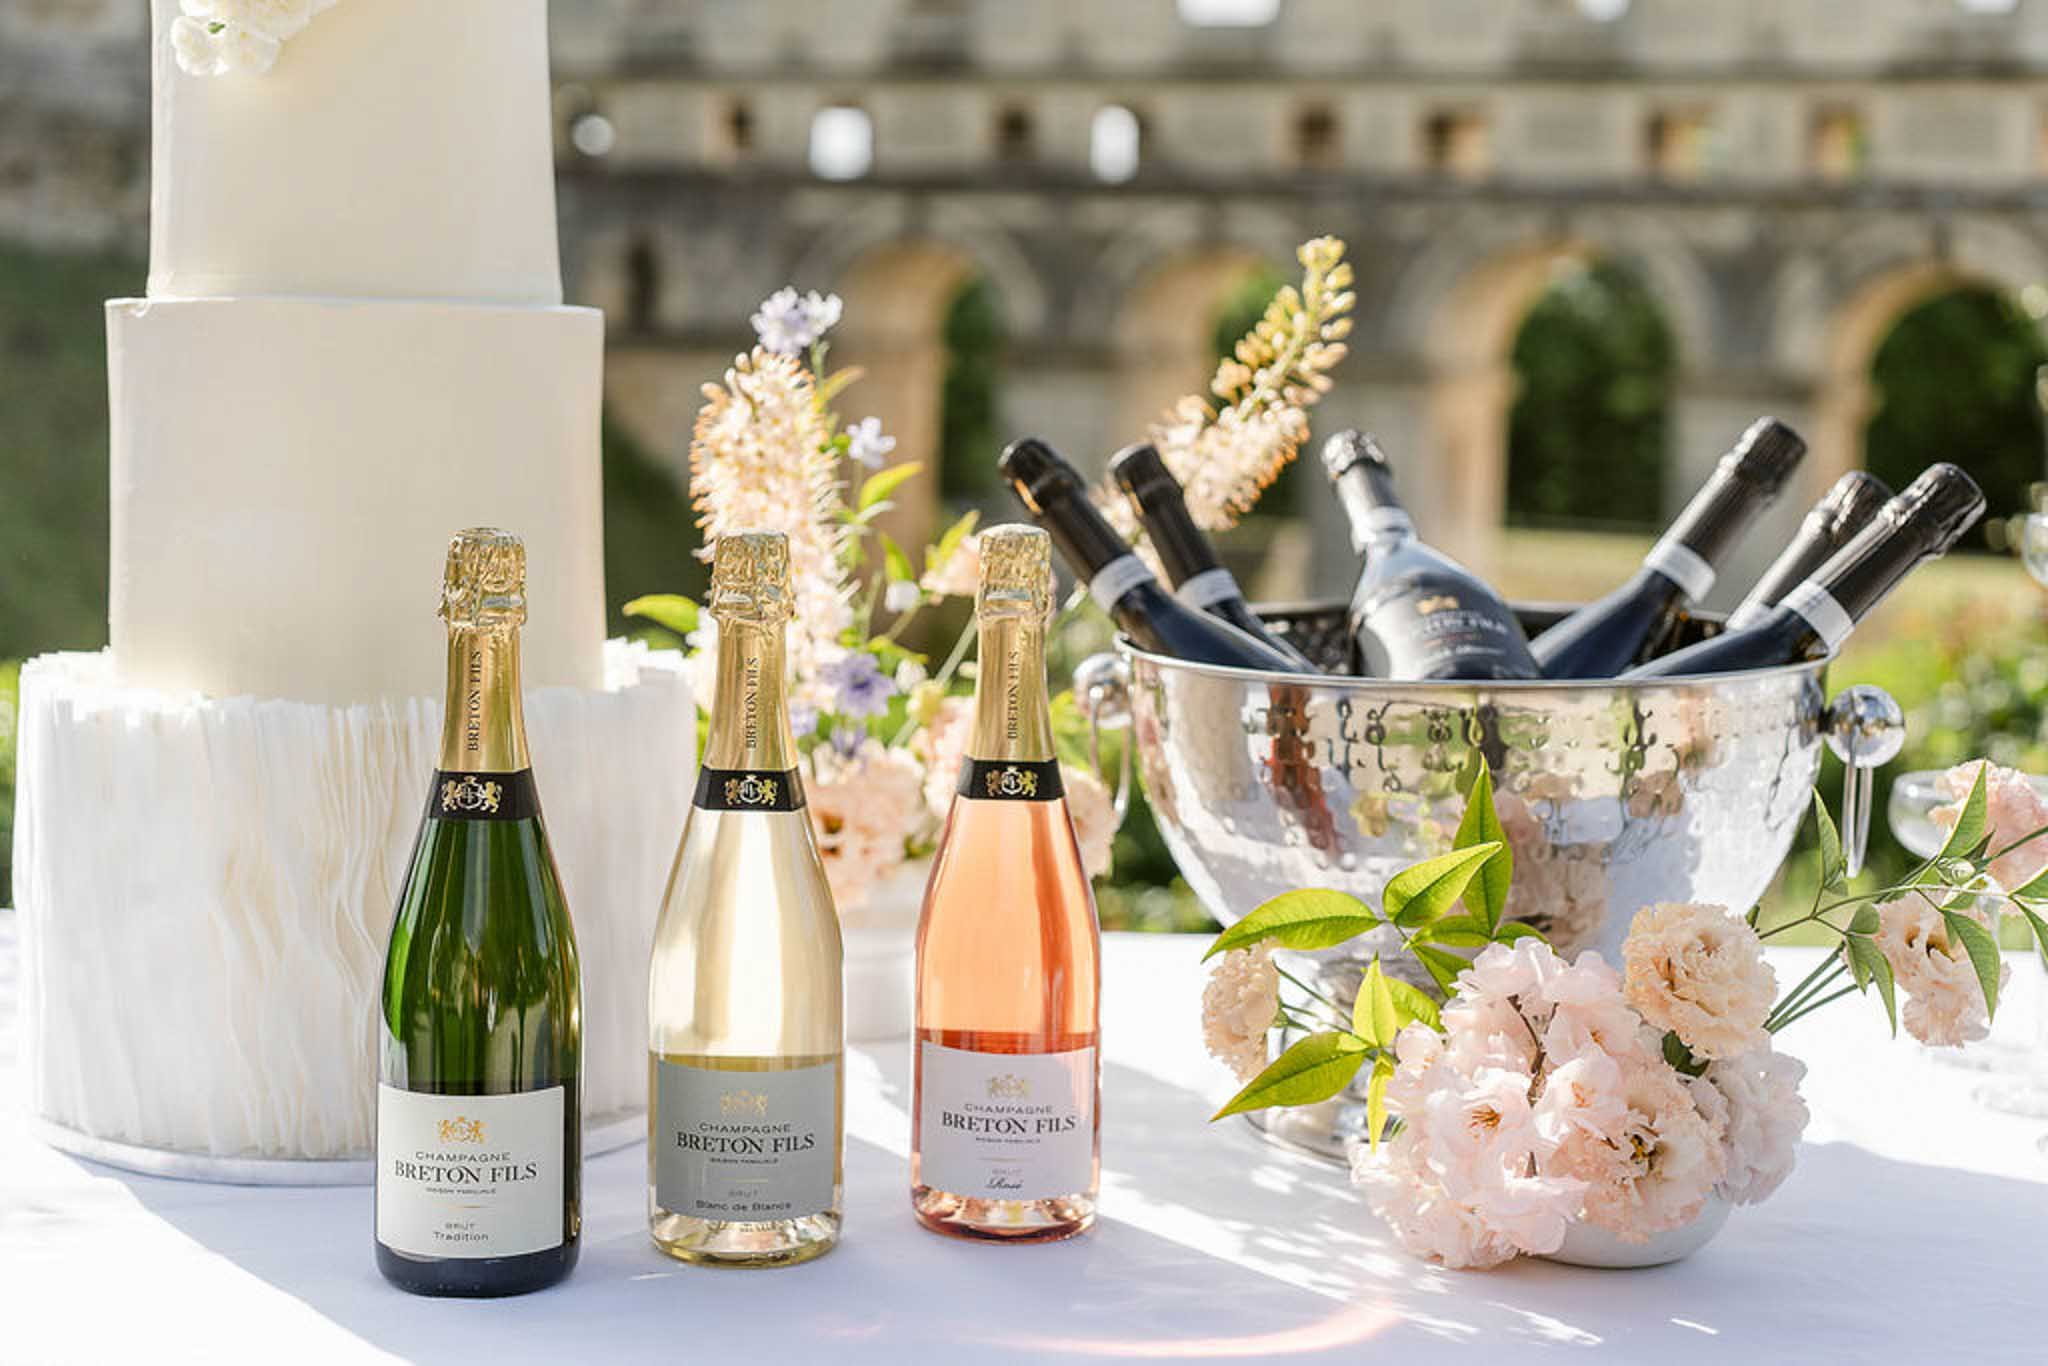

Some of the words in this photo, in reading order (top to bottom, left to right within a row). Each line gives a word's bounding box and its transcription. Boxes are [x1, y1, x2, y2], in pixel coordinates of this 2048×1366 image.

[471, 650, 482, 683] FILS
[467, 689, 482, 752] BRETON
[745, 690, 759, 749] BRETON
[1007, 684, 1019, 739] BRETON
[964, 1103, 1054, 1114] CHAMPAGNE
[698, 1123, 792, 1134] CHAMPAGNE
[942, 1111, 1027, 1135] BRETON
[1036, 1115, 1077, 1134] FILS
[676, 1131, 764, 1155] BRETON
[772, 1133, 816, 1153] FILS
[415, 1151, 512, 1163] CHAMPAGNE
[394, 1159, 481, 1185] BRETON
[490, 1162, 538, 1184] FILS
[695, 1199, 729, 1211] Blanc
[731, 1201, 749, 1211] de
[433, 1231, 490, 1243] Tradition
[445, 1222, 476, 1230] BRUT
